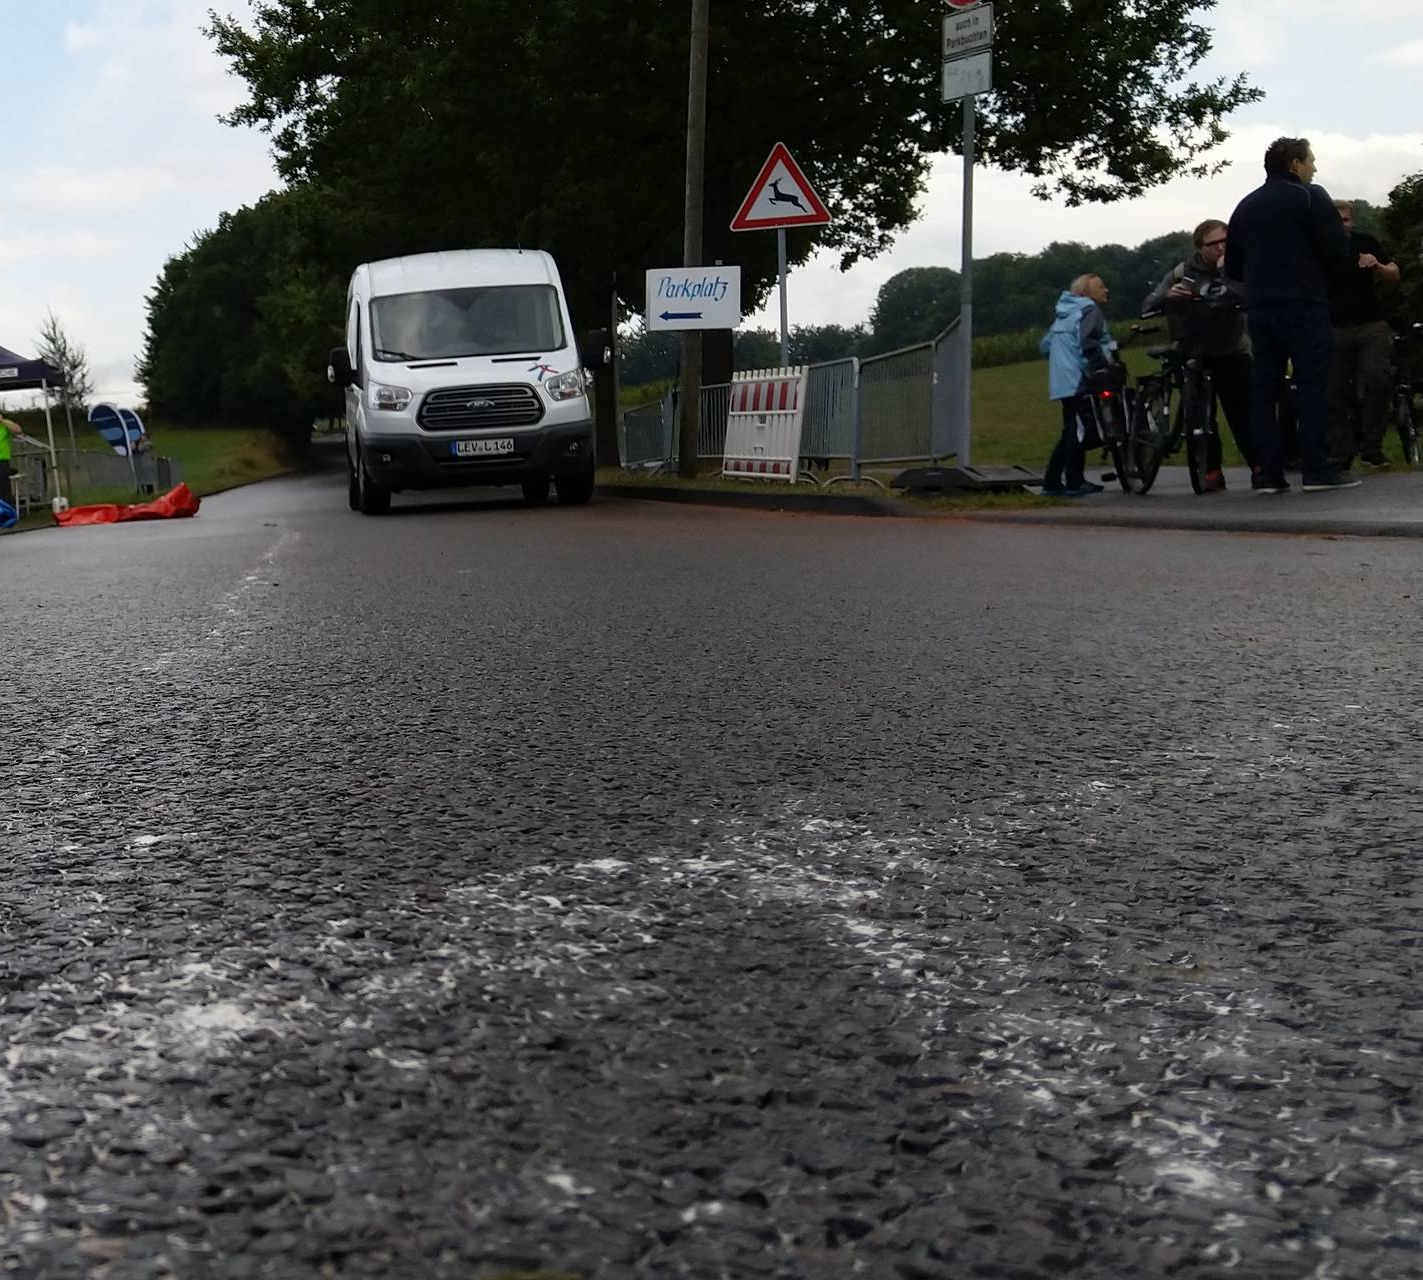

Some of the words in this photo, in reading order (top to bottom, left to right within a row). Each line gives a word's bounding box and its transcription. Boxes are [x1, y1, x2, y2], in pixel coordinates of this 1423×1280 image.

[657, 276, 728, 301] Parkplatz
[457, 442, 478, 453] LEV
[493, 440, 513, 451] 146
